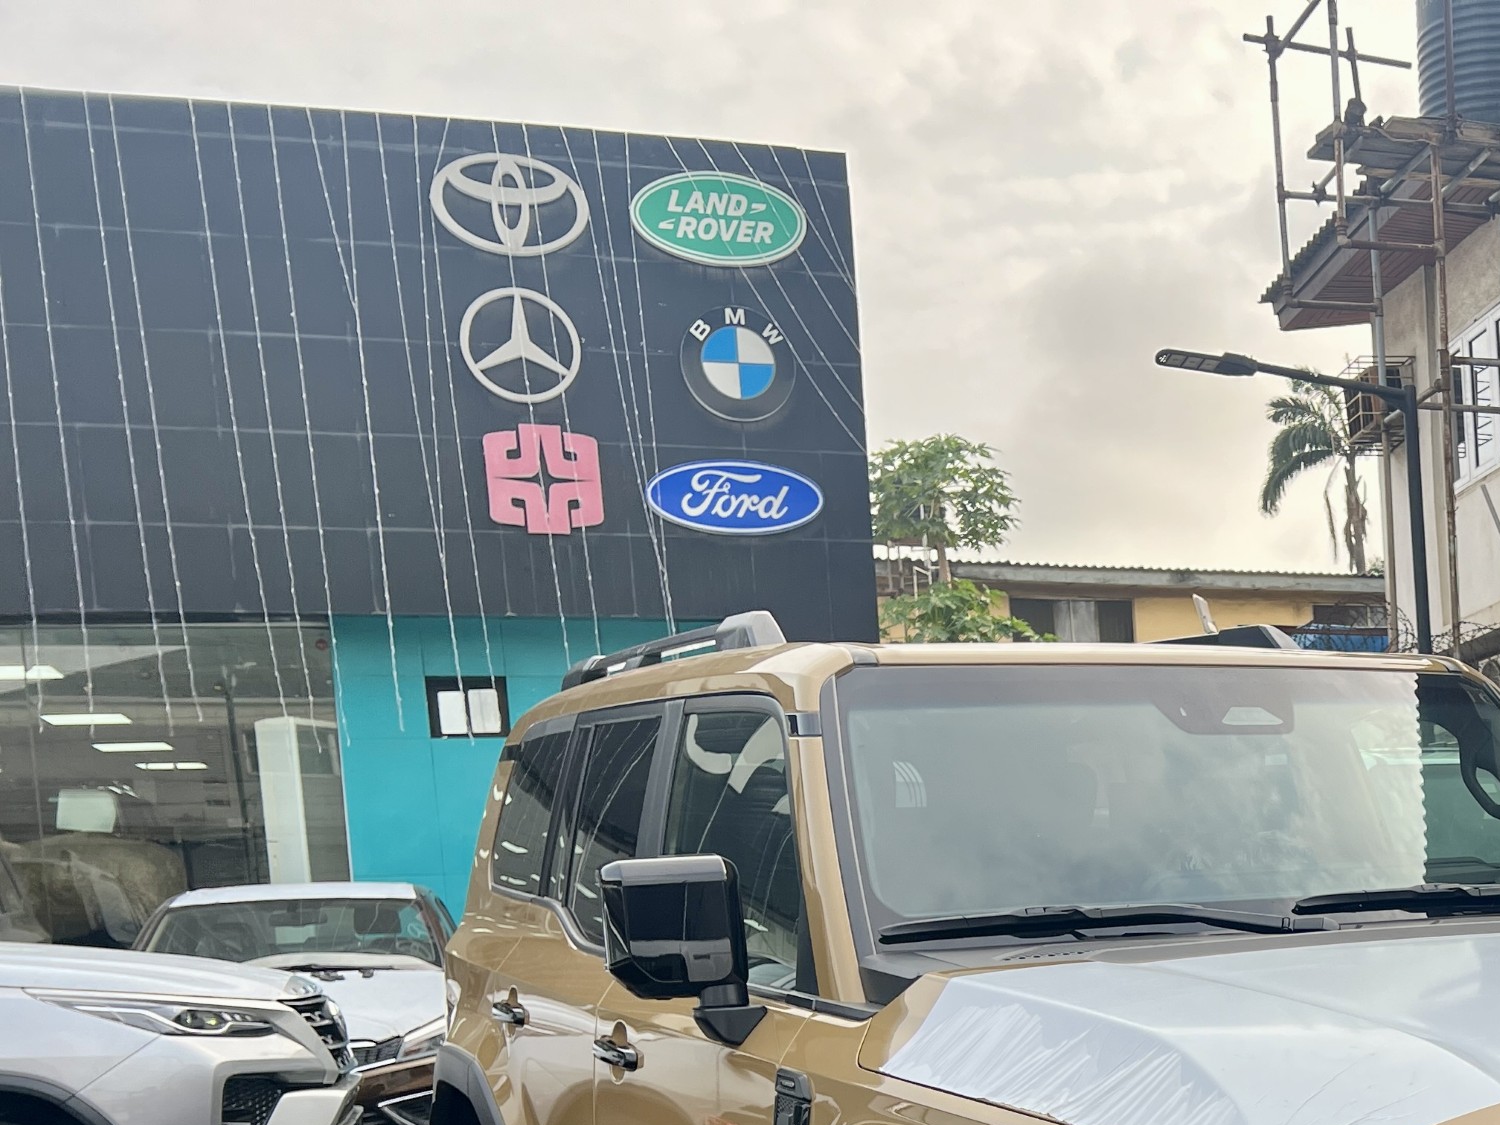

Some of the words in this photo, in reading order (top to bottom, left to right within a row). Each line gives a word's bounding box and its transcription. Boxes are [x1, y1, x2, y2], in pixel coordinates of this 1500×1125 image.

[667, 189, 748, 217] LAND
[676, 216, 774, 244] ROVER
[689, 307, 784, 345] BMW
[681, 469, 790, 519] Ford
